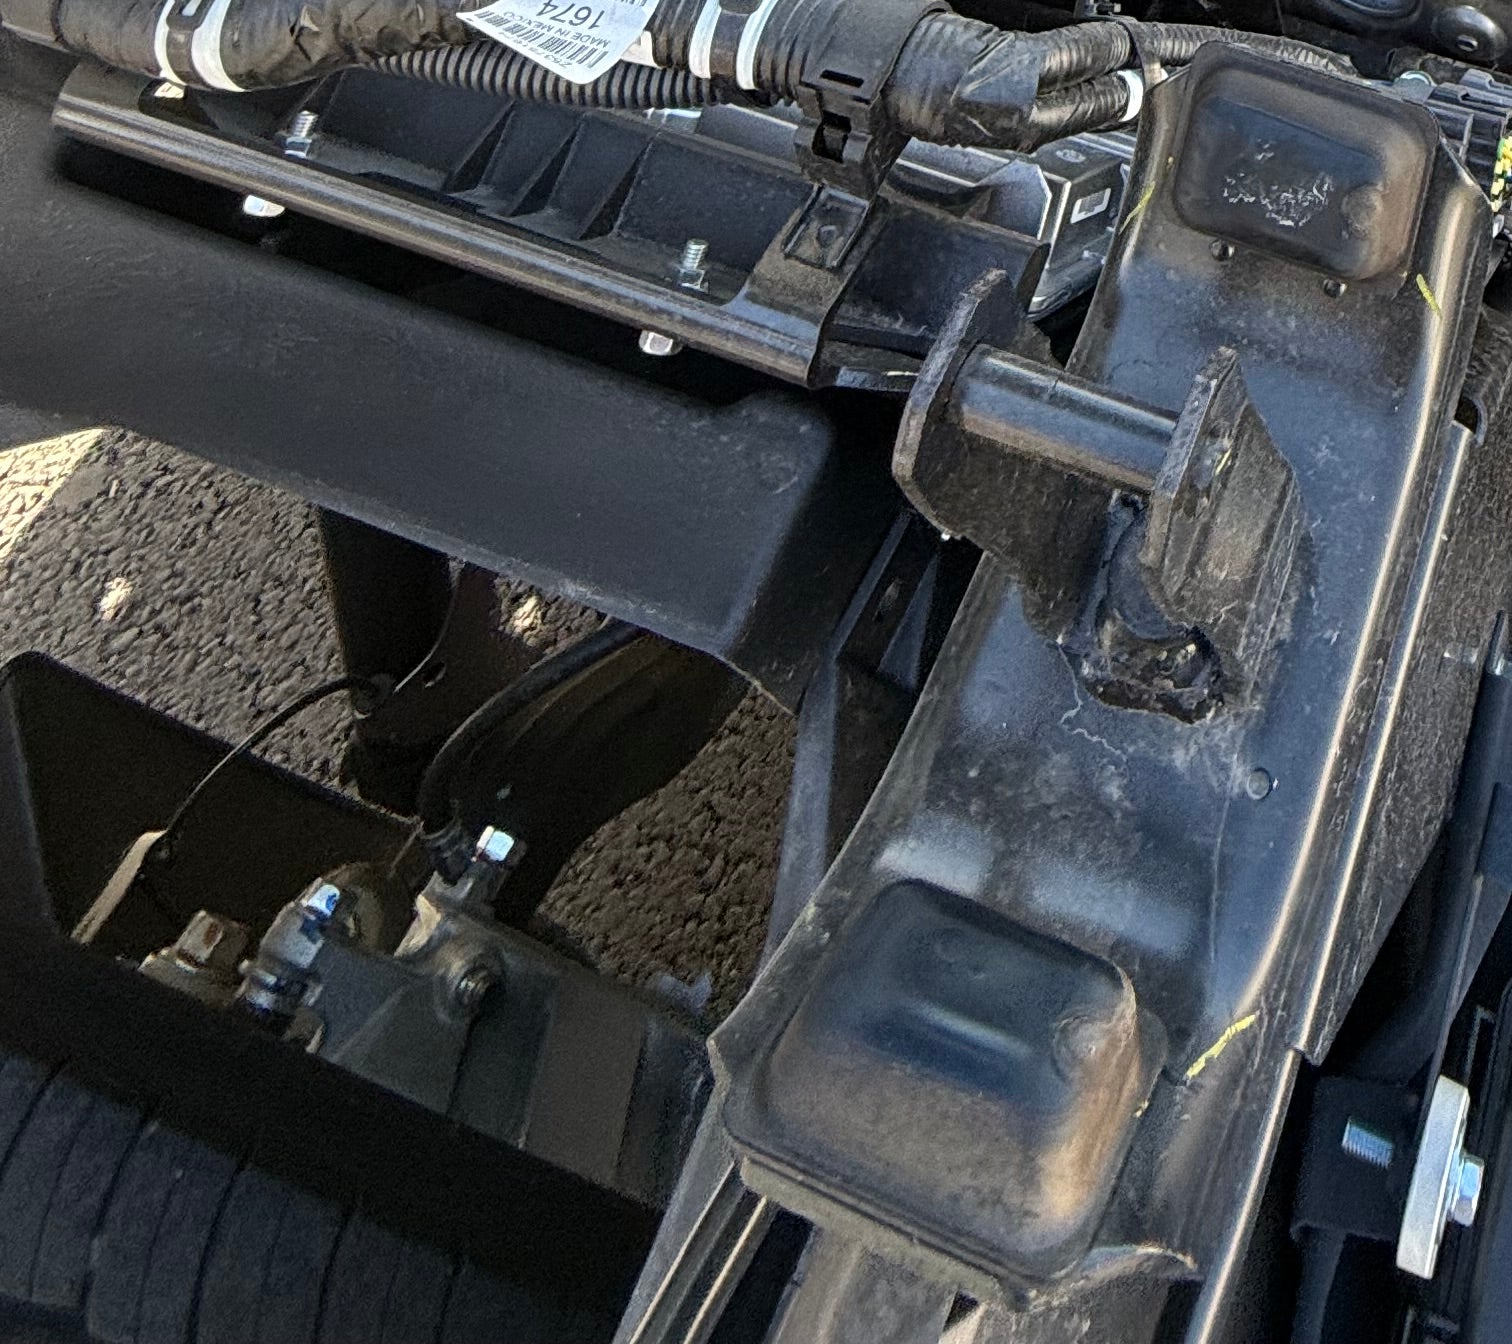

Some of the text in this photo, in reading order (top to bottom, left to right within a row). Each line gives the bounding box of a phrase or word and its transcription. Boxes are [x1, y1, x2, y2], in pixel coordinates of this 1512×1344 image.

[503, 11, 611, 49] MADE IN MEXICO
